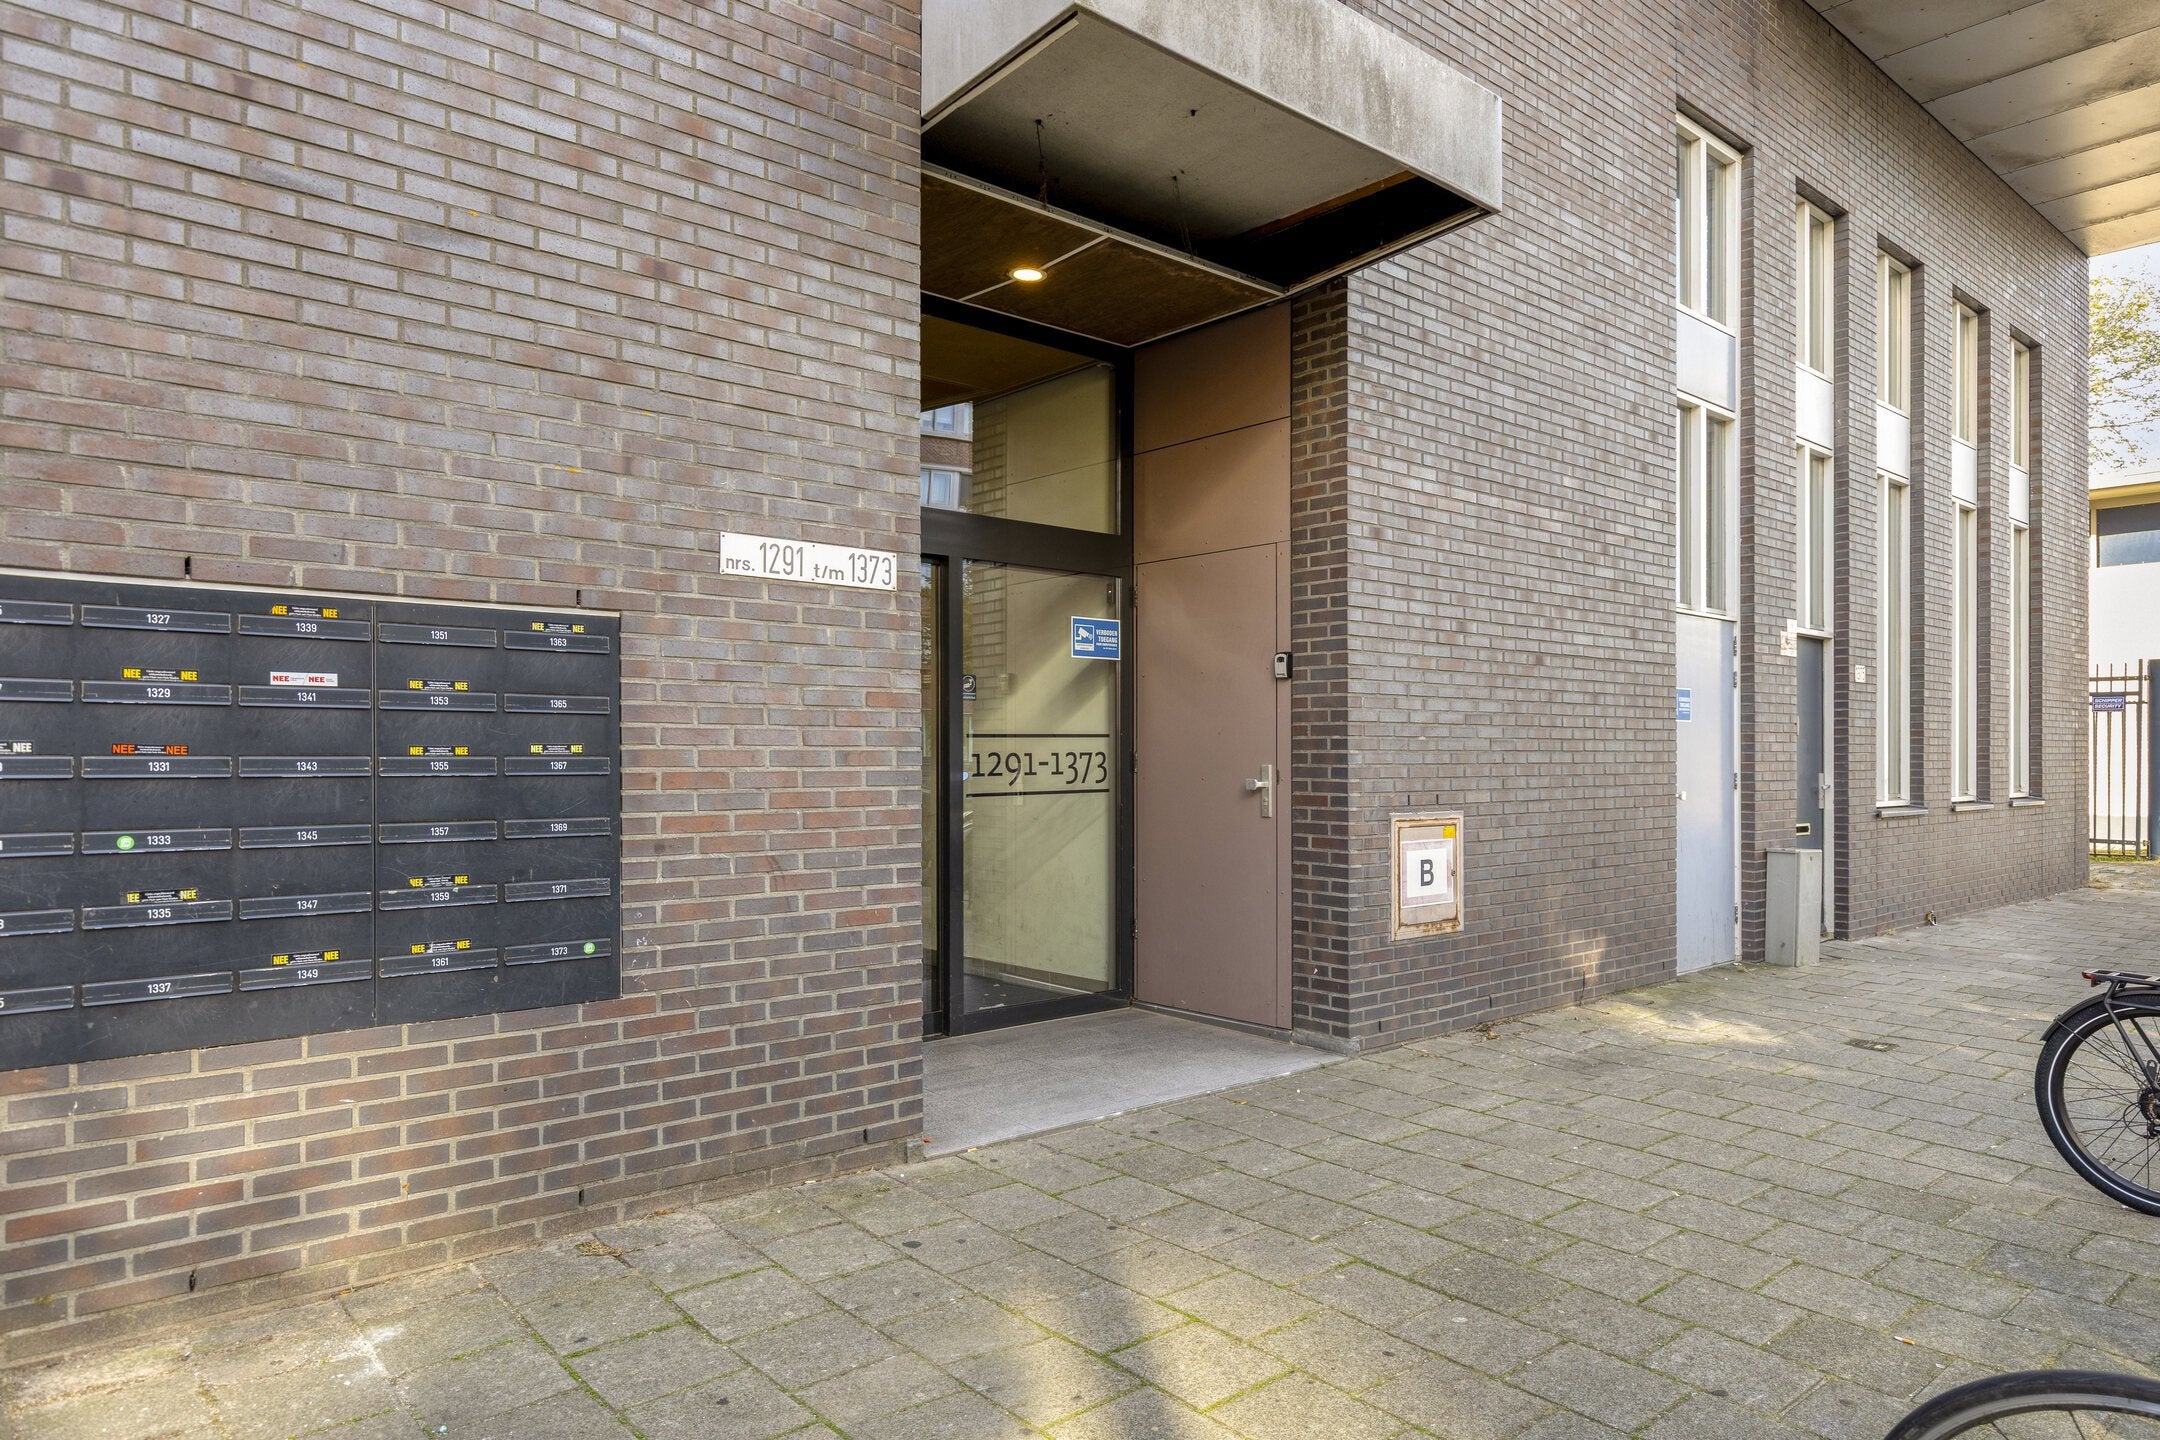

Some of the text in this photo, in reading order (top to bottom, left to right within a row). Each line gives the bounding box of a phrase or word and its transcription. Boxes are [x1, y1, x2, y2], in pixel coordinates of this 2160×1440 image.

[725, 542, 892, 586] nrs. 1291 t/m 1373
[272, 605, 287, 615] NEE
[323, 608, 338, 618] NEE
[147, 614, 170, 624] 1327
[296, 623, 317, 632] 1339
[532, 622, 544, 631] NEE
[572, 624, 584, 633] NEE
[431, 631, 447, 639] 1351
[550, 638, 566, 647] 1363
[124, 668, 141, 679] NEE
[181, 671, 197, 681] NEE
[410, 680, 423, 689] NEE
[455, 682, 468, 691] NEE
[147, 688, 170, 698] 1329
[298, 692, 316, 702] 1341
[430, 697, 449, 705] 1353
[550, 700, 567, 708] 1365
[13, 742, 32, 752] NEE
[113, 744, 135, 754] NEE
[166, 746, 188, 755] NEE
[410, 746, 423, 755] NEE
[455, 747, 468, 755] NEE
[530, 745, 543, 753] NEE
[571, 745, 583, 753] NEE
[148, 762, 170, 772] 1331
[297, 762, 317, 771] 1343
[430, 762, 449, 770] 1355
[550, 762, 567, 770] 1367
[972, 752, 1107, 787] 1291-1373
[430, 827, 449, 836] 1357
[550, 823, 567, 832] 1369
[147, 835, 171, 845] 1333
[297, 831, 318, 840] 1345
[1420, 858, 1435, 887] B
[410, 878, 423, 887] NEE
[455, 875, 468, 884] NEE
[552, 885, 567, 893] 1371
[180, 890, 197, 900] NEE
[431, 893, 450, 901] 1359
[297, 900, 318, 910] 1347
[148, 909, 171, 919] 1335
[411, 944, 425, 953] NEE
[456, 940, 470, 949] NEE
[551, 947, 568, 956] 1373
[273, 955, 289, 965] NEE
[324, 950, 339, 960] NEE
[431, 958, 449, 967] 1361
[297, 969, 318, 979] 1349
[148, 983, 171, 993] 1337
